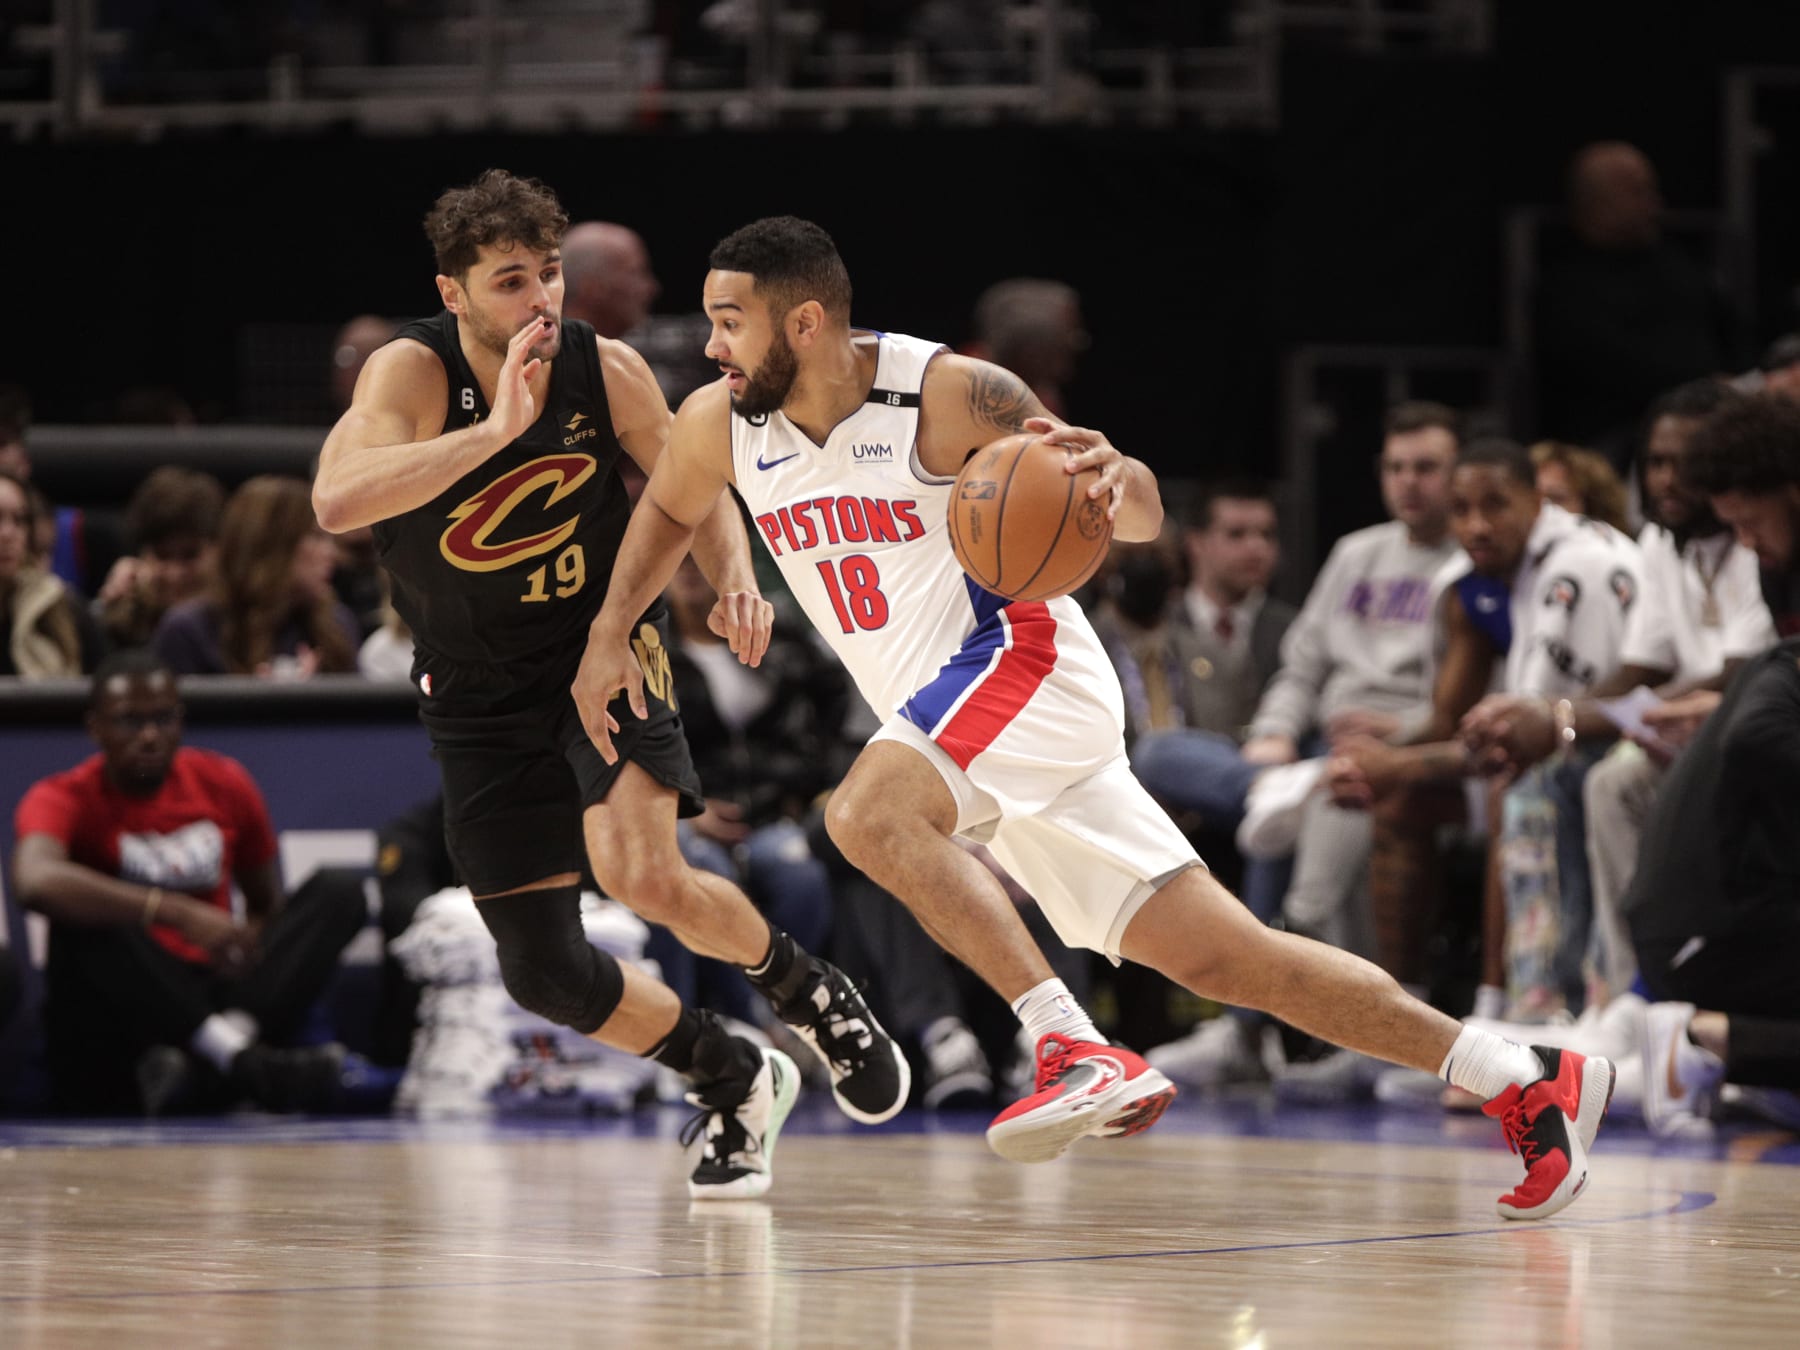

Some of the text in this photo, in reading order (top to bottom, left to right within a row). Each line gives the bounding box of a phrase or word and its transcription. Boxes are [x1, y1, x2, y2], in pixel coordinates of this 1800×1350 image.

[461, 388, 475, 410] 6
[886, 392, 901, 406] 16
[563, 428, 597, 446] CLIFFS
[852, 443, 893, 458] UWM
[755, 496, 926, 557] PISTONS
[520, 544, 586, 603] 19
[816, 554, 889, 634] 18
